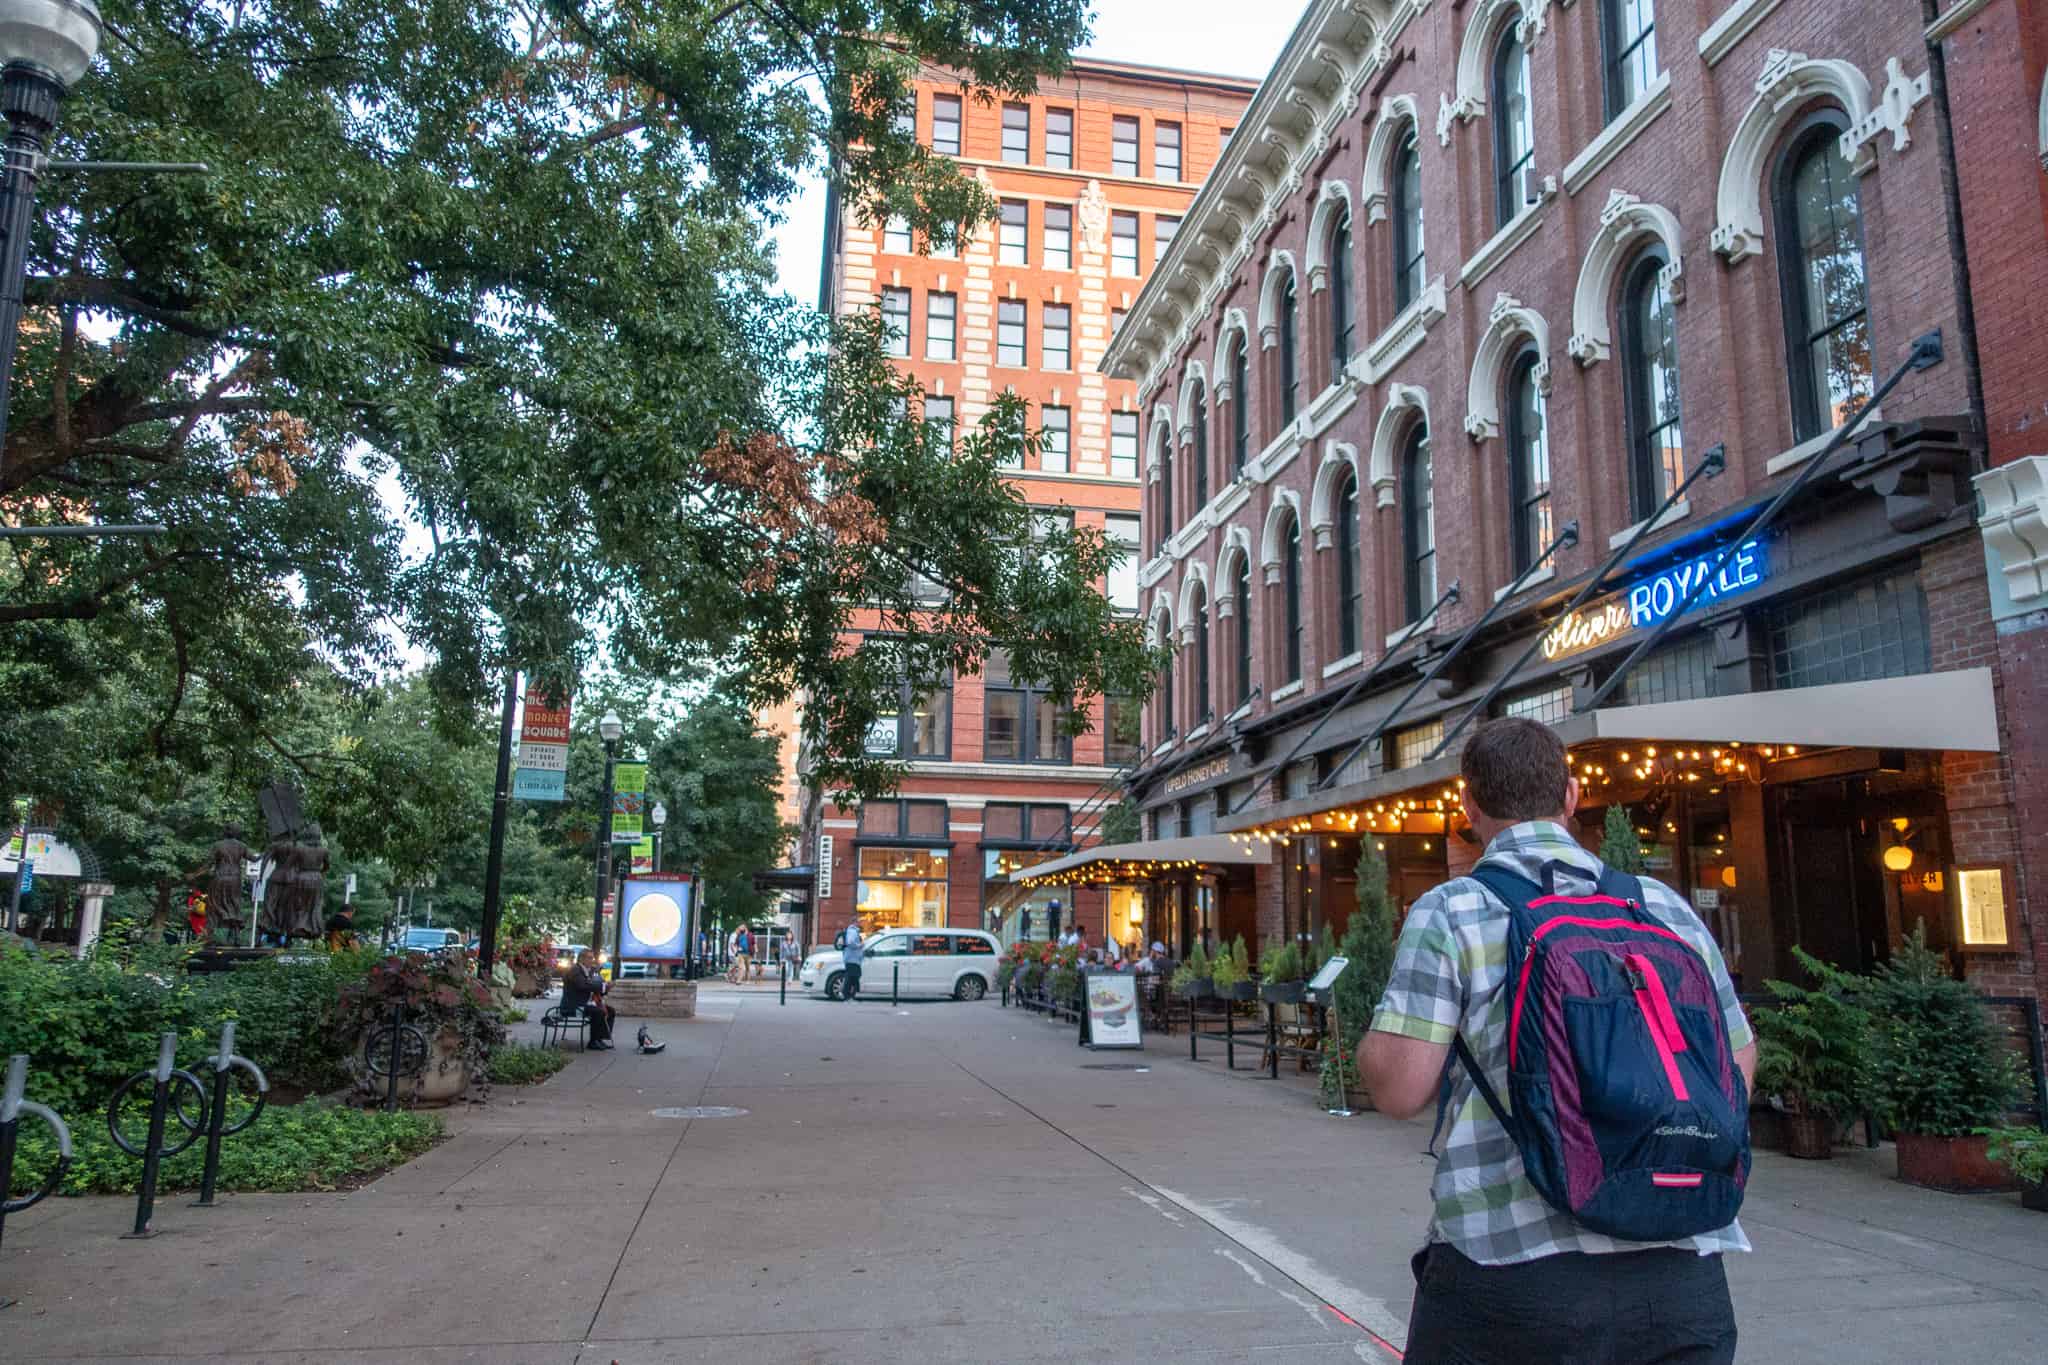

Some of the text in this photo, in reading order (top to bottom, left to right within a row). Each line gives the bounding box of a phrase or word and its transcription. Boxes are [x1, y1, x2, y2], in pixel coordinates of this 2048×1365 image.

[1629, 541, 1759, 626] ROYALE
[525, 711, 567, 724] MARKET
[523, 726, 566, 737] SQUARE
